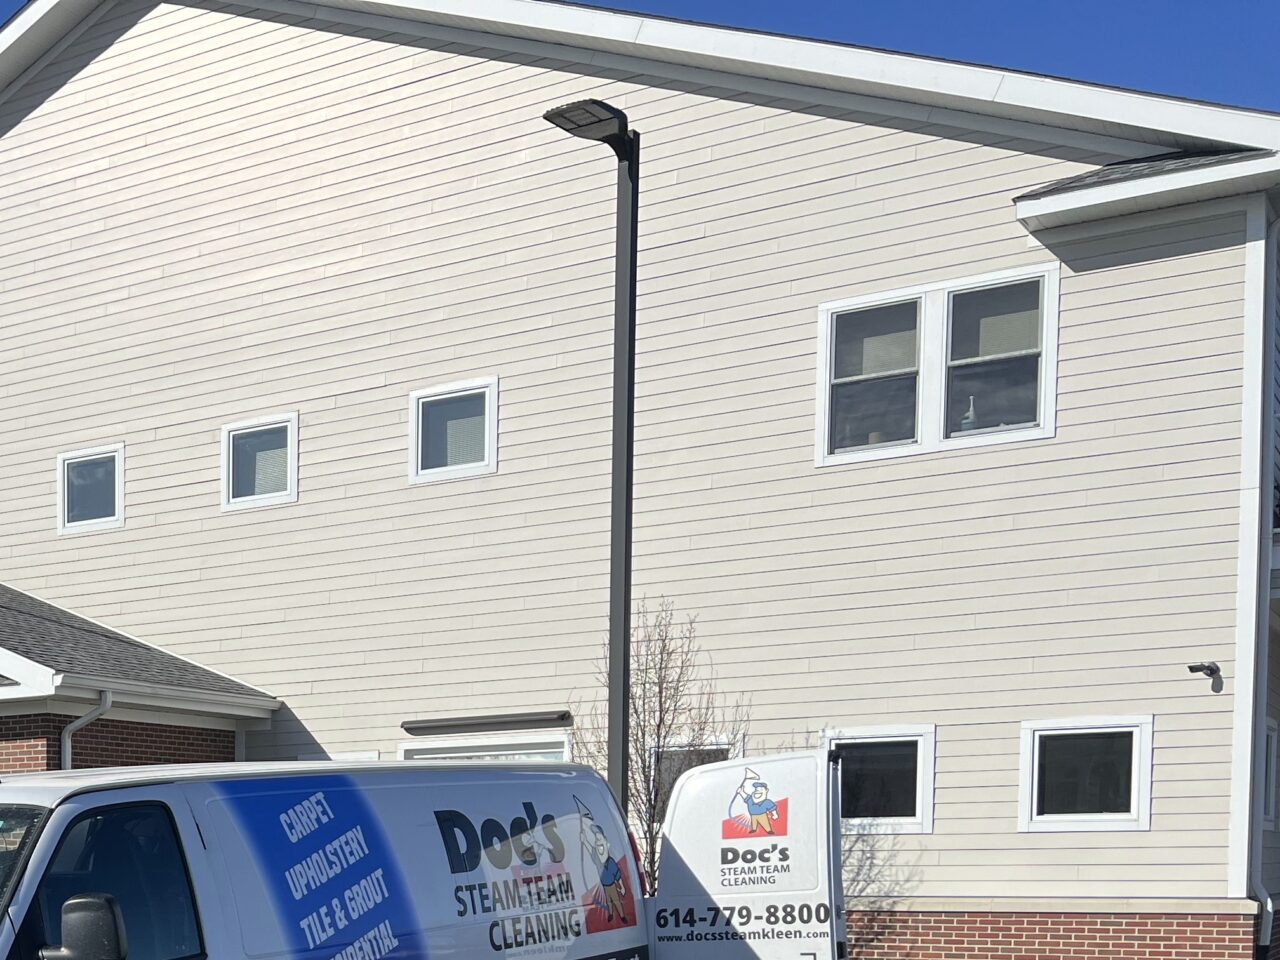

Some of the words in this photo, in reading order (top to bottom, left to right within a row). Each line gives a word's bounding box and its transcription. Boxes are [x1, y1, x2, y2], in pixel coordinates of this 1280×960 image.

[280, 791, 335, 844] CARPET
[433, 801, 566, 875] Doc's
[284, 825, 369, 901] UPHOLSTERY
[720, 844, 790, 865] Doc's
[720, 865, 758, 876] STEAM
[759, 864, 791, 875] TEAM
[454, 878, 522, 918] STEAM
[521, 871, 576, 907] TEAM
[720, 875, 776, 888] CLEANING
[299, 904, 335, 950] TILE
[331, 897, 348, 930] &
[344, 868, 389, 920] GROUT
[489, 909, 582, 952] CLEANING
[656, 903, 830, 929] 614-779-8800
[657, 929, 829, 942] www.docssteamkleen.com
